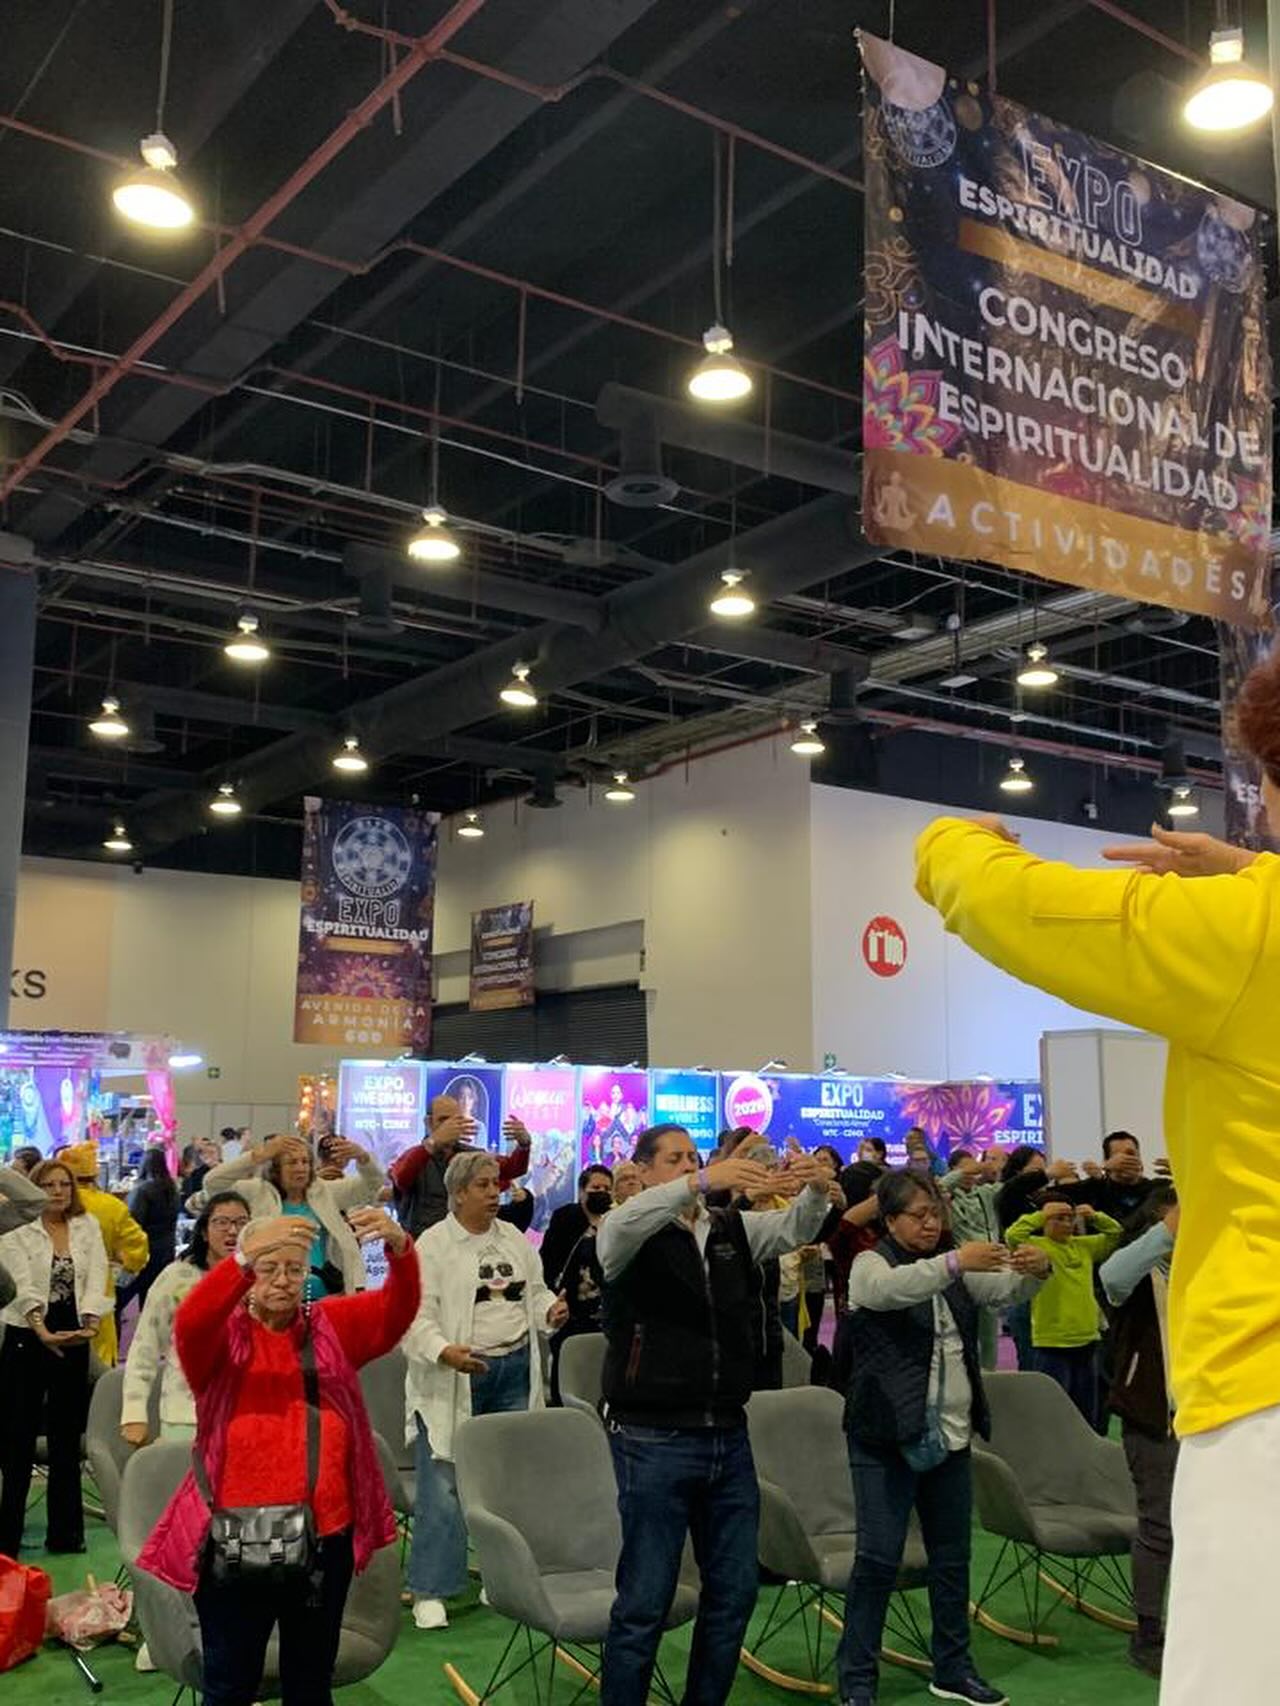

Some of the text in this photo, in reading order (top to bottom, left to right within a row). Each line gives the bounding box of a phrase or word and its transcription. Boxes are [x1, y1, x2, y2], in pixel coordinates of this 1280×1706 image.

[958, 177, 1200, 300] ESPIRITUALIDAD
[1019, 140, 1144, 247] EXPO
[897, 311, 1263, 466] INTERNACIONAL DE
[978, 287, 1188, 389] CONGRESO
[938, 380, 1239, 512] ESPIRITUALIDAD
[926, 493, 1247, 600] ACTIVIDADES
[306, 919, 430, 942] ESPIRITUALIDAD
[339, 896, 400, 928] EXPO
[800, 1106, 885, 1121] ESPIRITUALIDAD
[821, 1081, 864, 1108] EXPO
